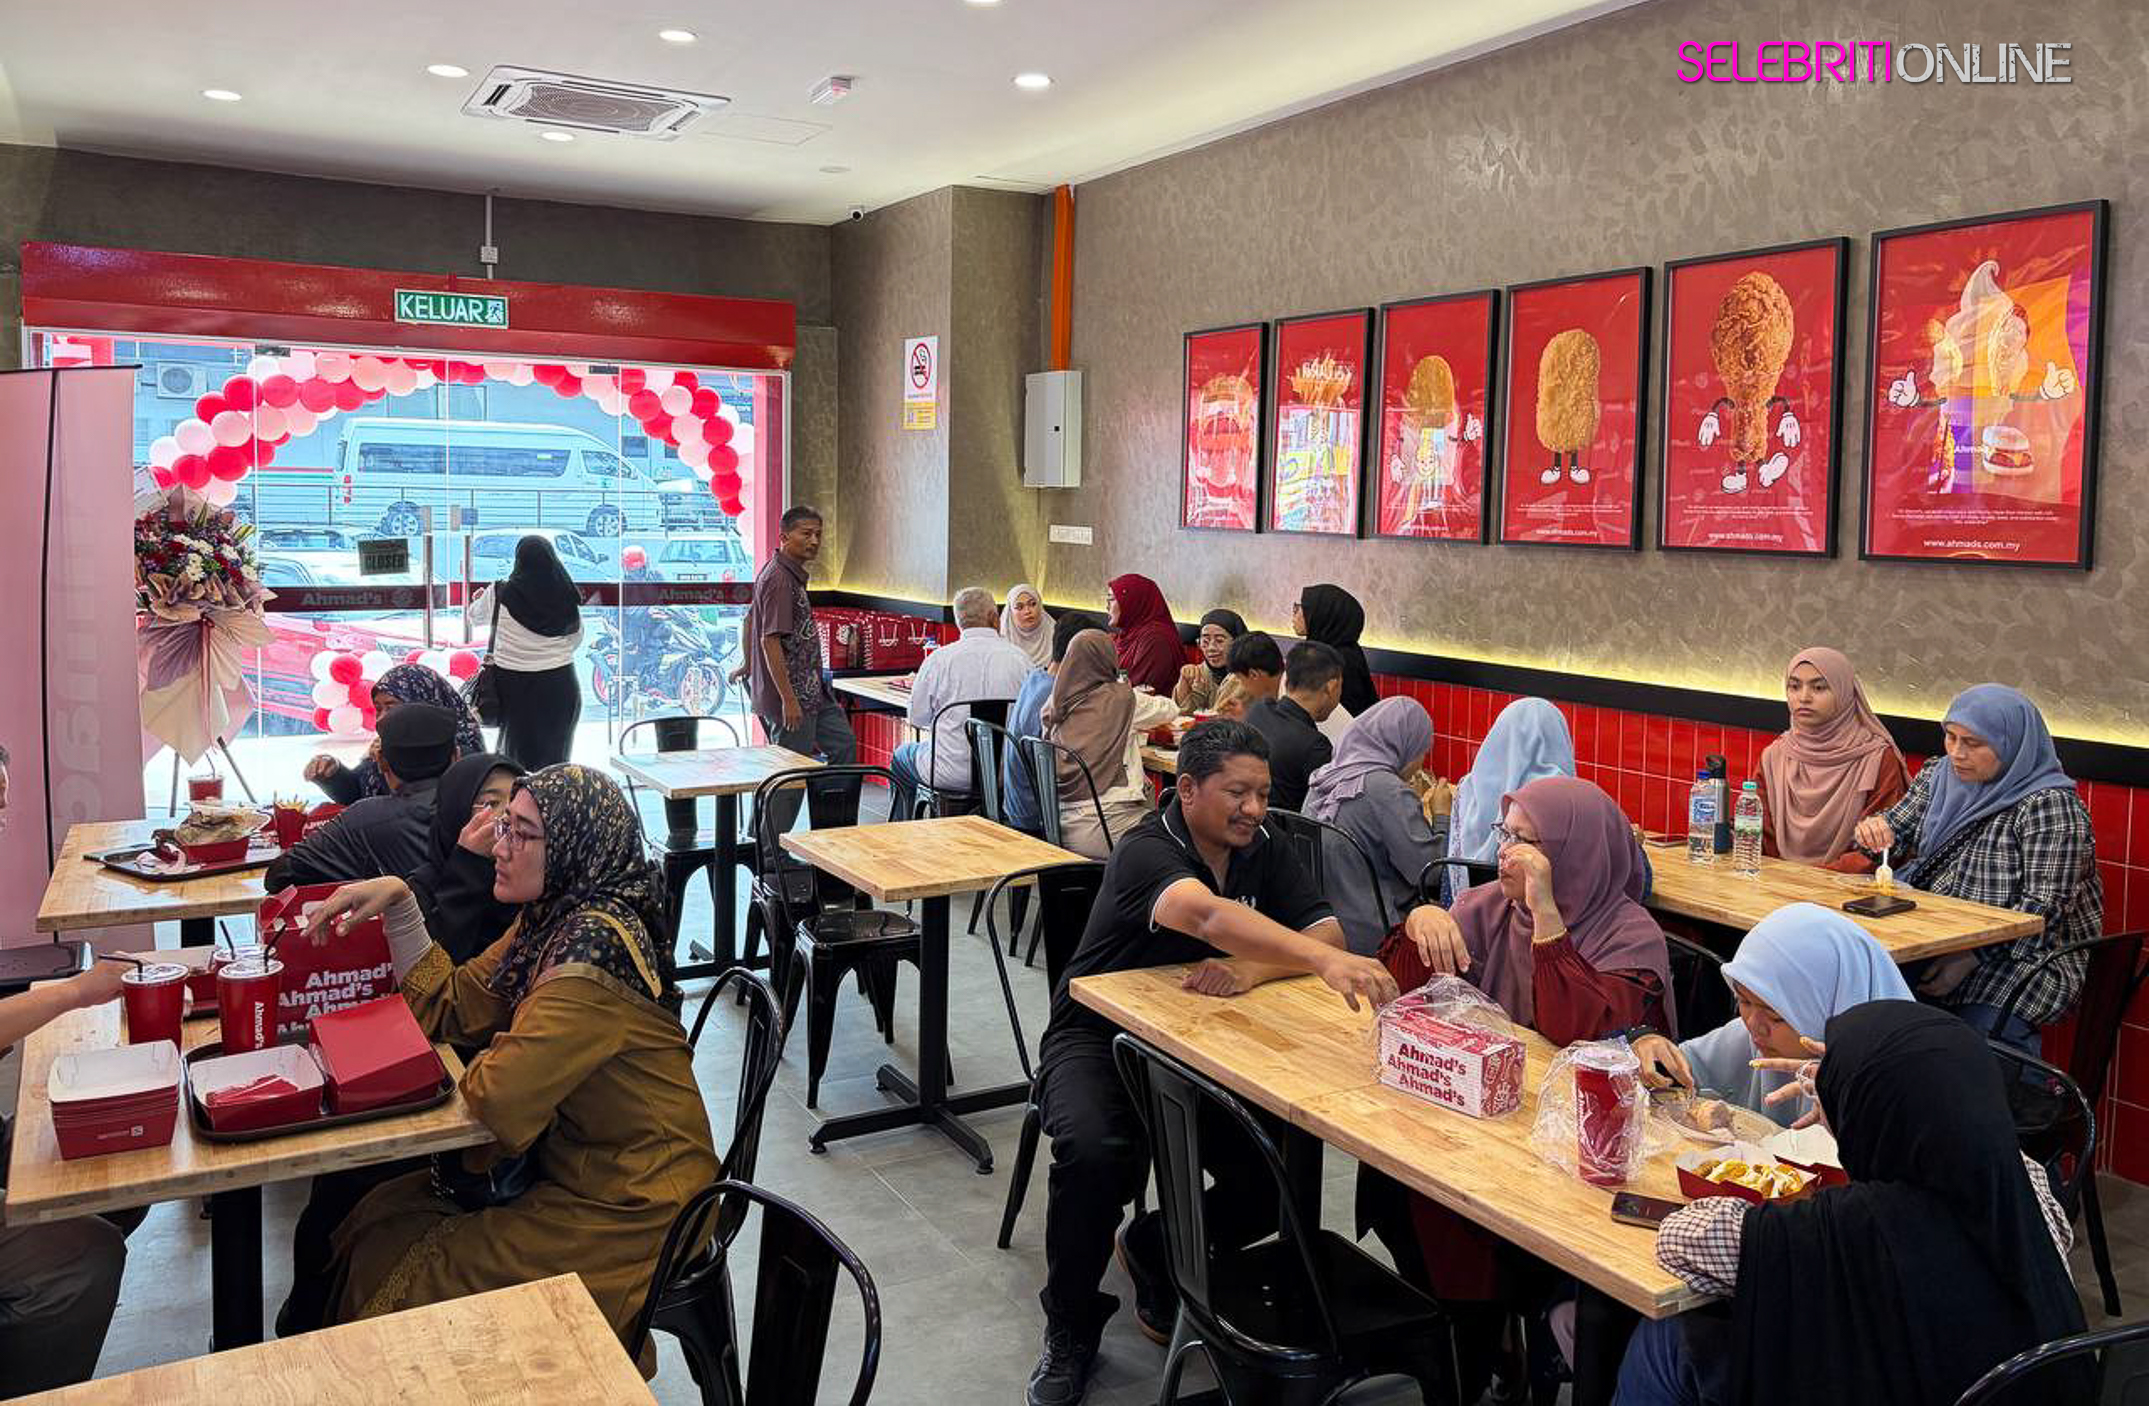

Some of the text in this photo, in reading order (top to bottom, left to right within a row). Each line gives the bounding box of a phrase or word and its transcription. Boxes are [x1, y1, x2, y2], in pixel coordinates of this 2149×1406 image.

[400, 293, 484, 323] KELUAR
[1923, 539, 2020, 552] www.ahmads.com.my
[300, 591, 382, 606] Ahmad's
[305, 962, 393, 989] Ahmad'
[279, 981, 375, 1006] Ahmad's
[254, 1001, 265, 1050] Ahmad's
[1388, 1053, 1452, 1087] Ahmad's
[1398, 1043, 1467, 1076] Ahmad's
[1399, 1073, 1465, 1107] Ahmad's
